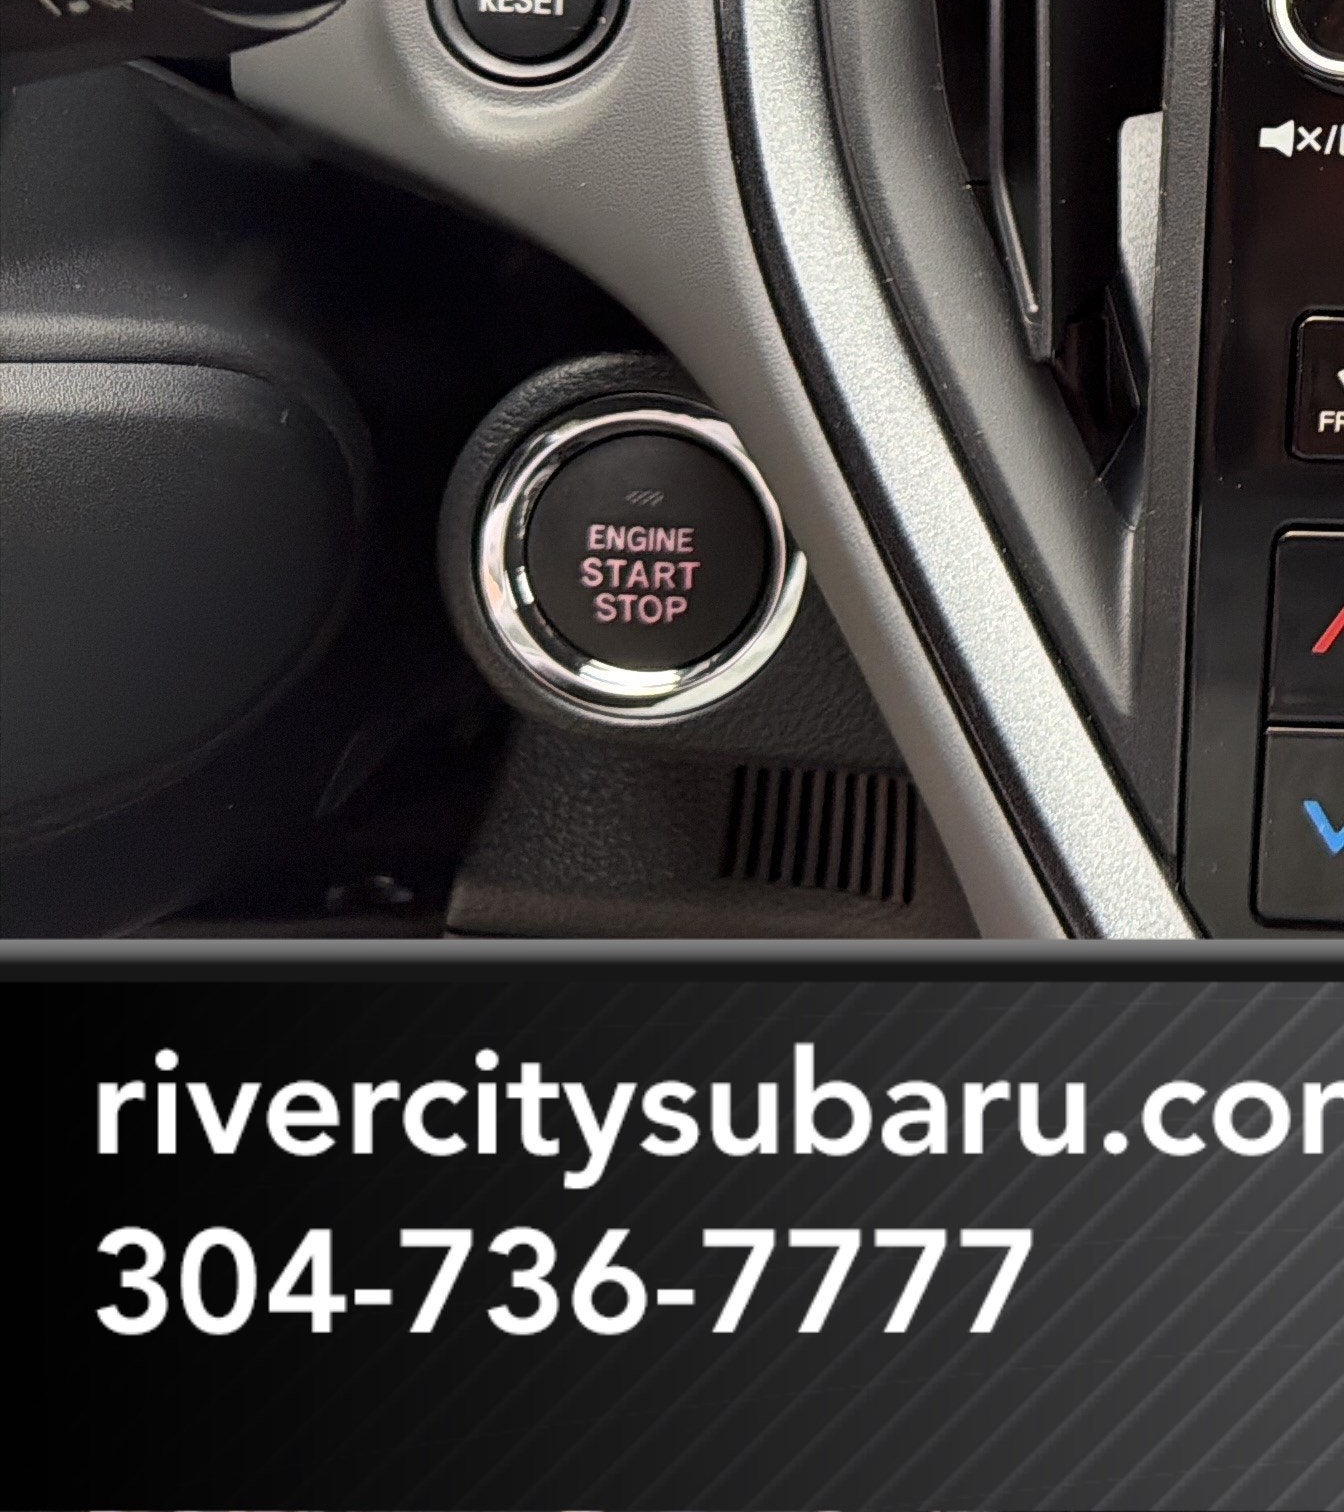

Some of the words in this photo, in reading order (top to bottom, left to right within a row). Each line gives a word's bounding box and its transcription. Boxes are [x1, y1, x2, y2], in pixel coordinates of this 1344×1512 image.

[588, 524, 694, 552] ENGINE
[581, 557, 700, 590] START
[594, 594, 688, 623] STOP
